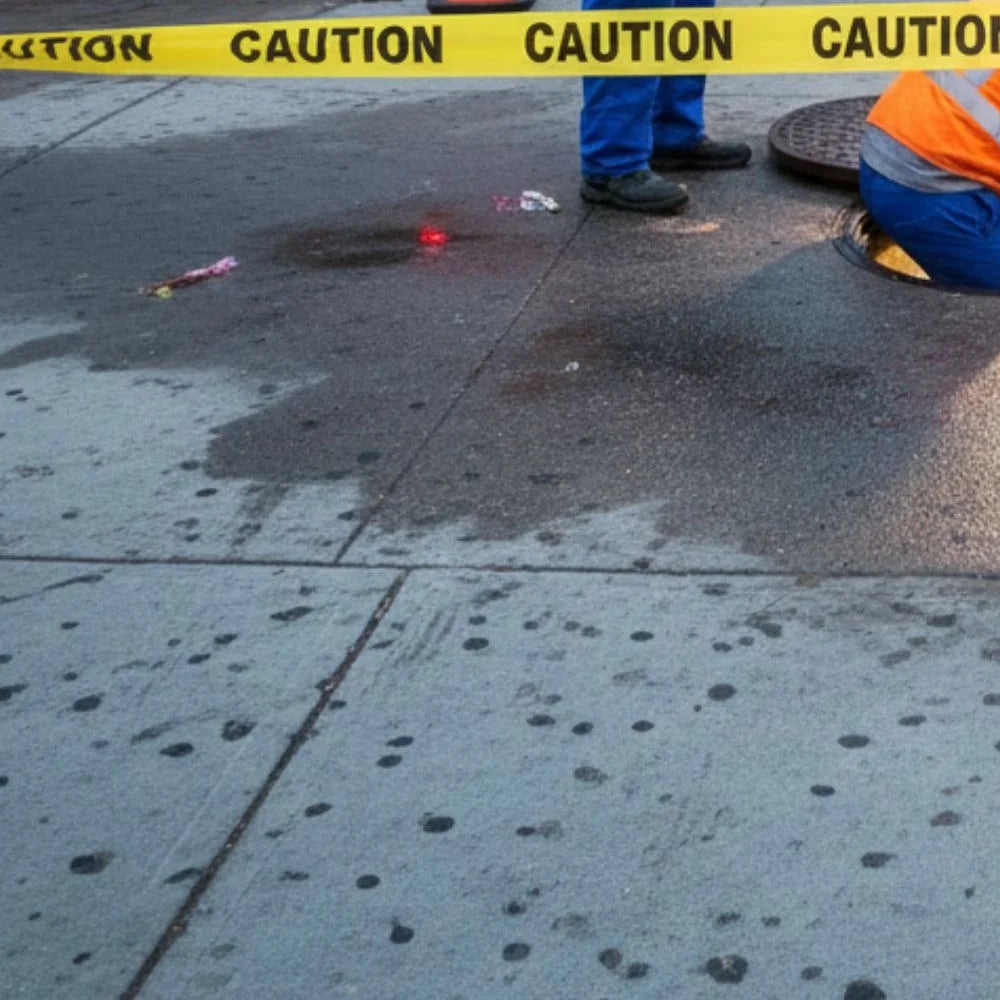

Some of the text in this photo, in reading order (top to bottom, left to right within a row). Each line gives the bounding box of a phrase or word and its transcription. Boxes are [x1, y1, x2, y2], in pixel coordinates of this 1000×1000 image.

[1, 33, 153, 62] UTION
[229, 25, 443, 64] CAUTION
[524, 19, 733, 63] CAUTION
